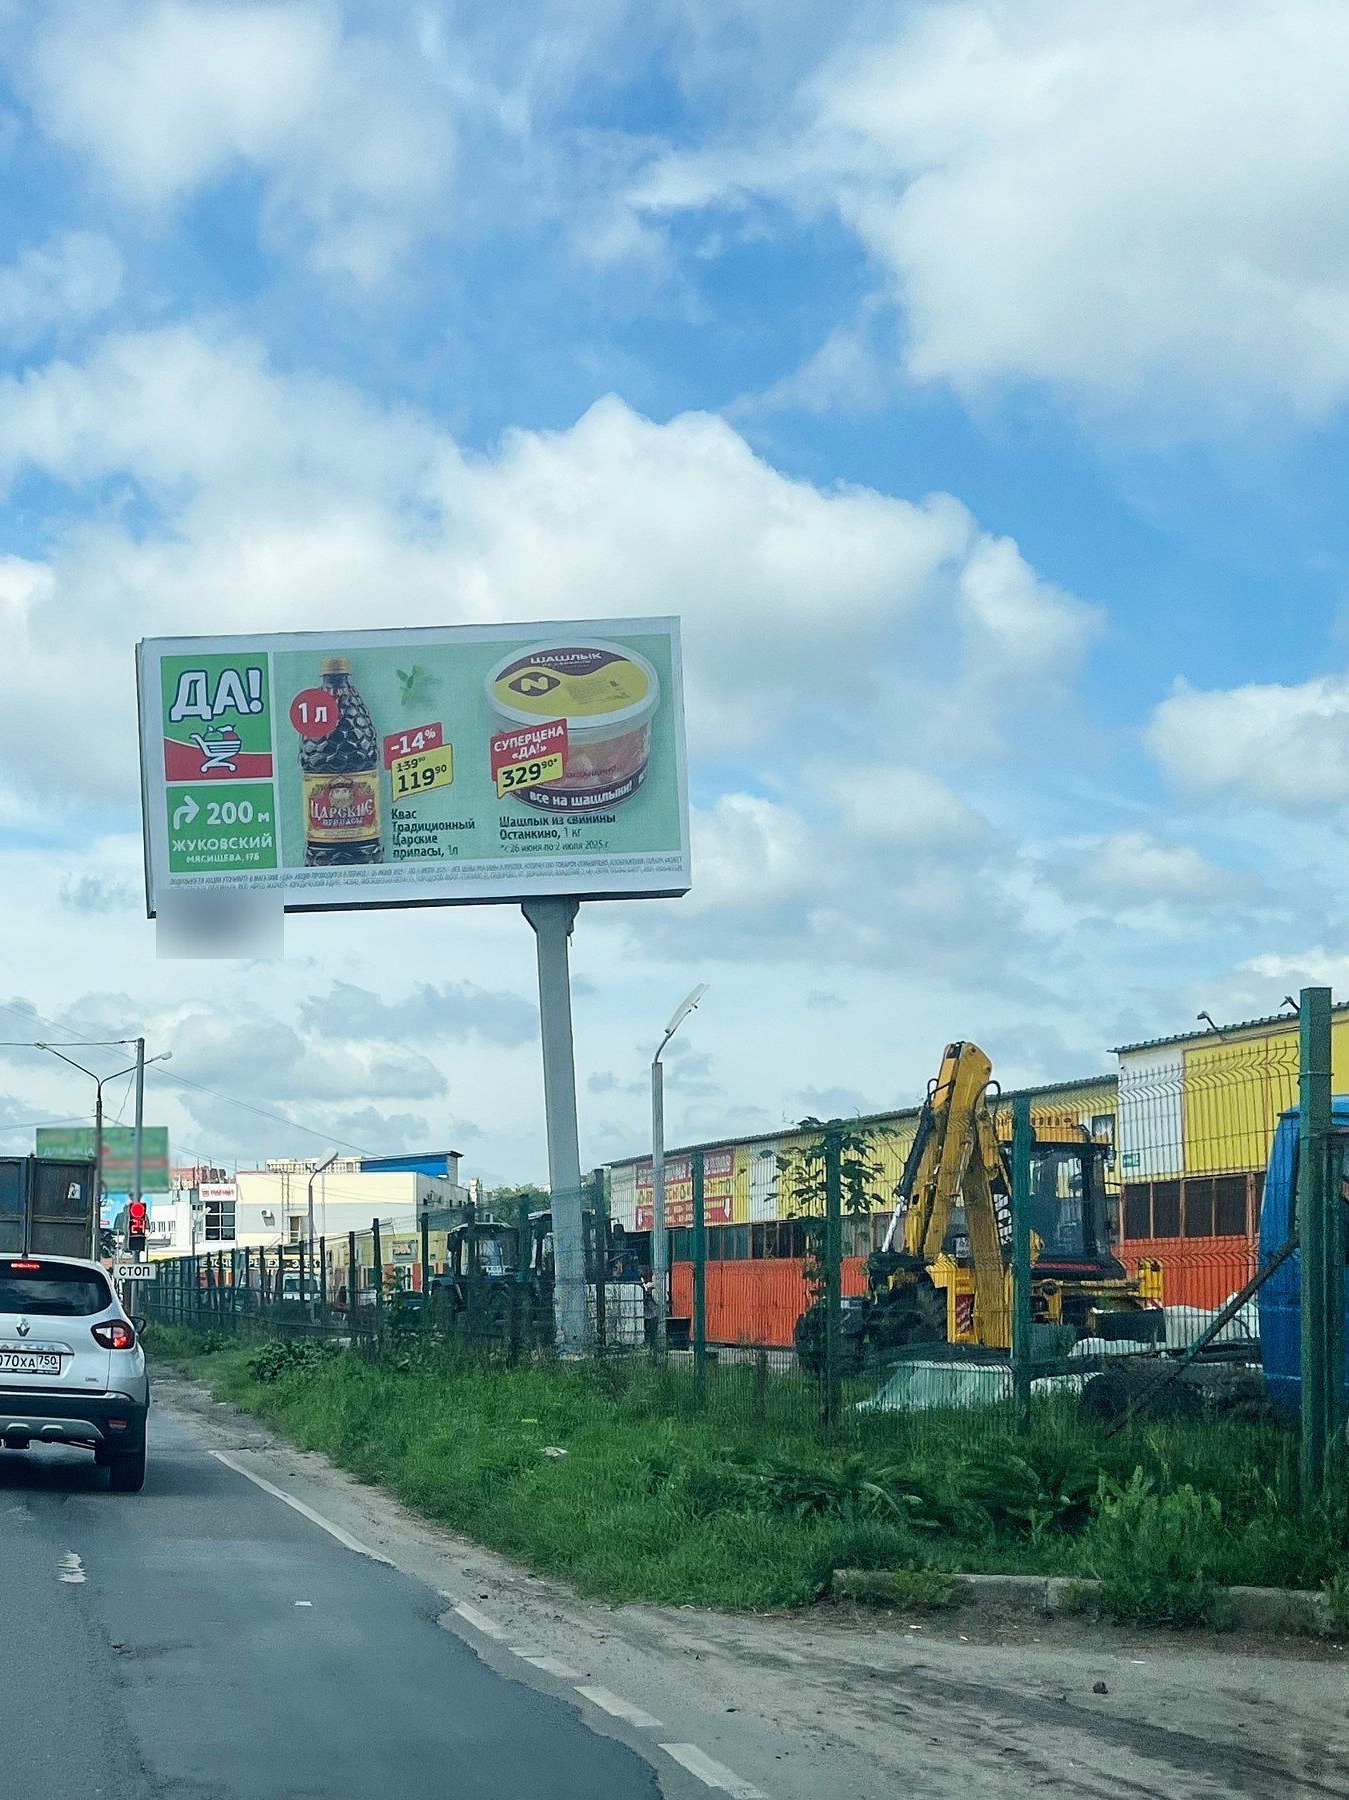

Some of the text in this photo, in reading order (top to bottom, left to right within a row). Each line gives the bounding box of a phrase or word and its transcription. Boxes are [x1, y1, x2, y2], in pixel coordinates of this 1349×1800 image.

[530, 652, 602, 664] ШАШЛЫК
[170, 668, 263, 722] ДА!
[298, 703, 328, 723] 1 л
[391, 728, 436, 754] -14%
[494, 725, 564, 752] СУПЕРЦЕНА
[511, 744, 547, 760] «ДА!»
[206, 801, 253, 825] 200
[391, 808, 417, 820] Квас
[392, 818, 476, 834] Традиционный
[500, 814, 616, 828] Шашлык из свинины
[392, 834, 438, 847] Царские
[500, 829, 561, 841] Останкино,
[172, 833, 273, 852] ЖУКОВСКИЙ
[393, 847, 445, 860] припасы,
[131, 1220, 146, 1234] 24
[119, 1266, 150, 1277] СТОП
[39, 1355, 57, 1366] 750
